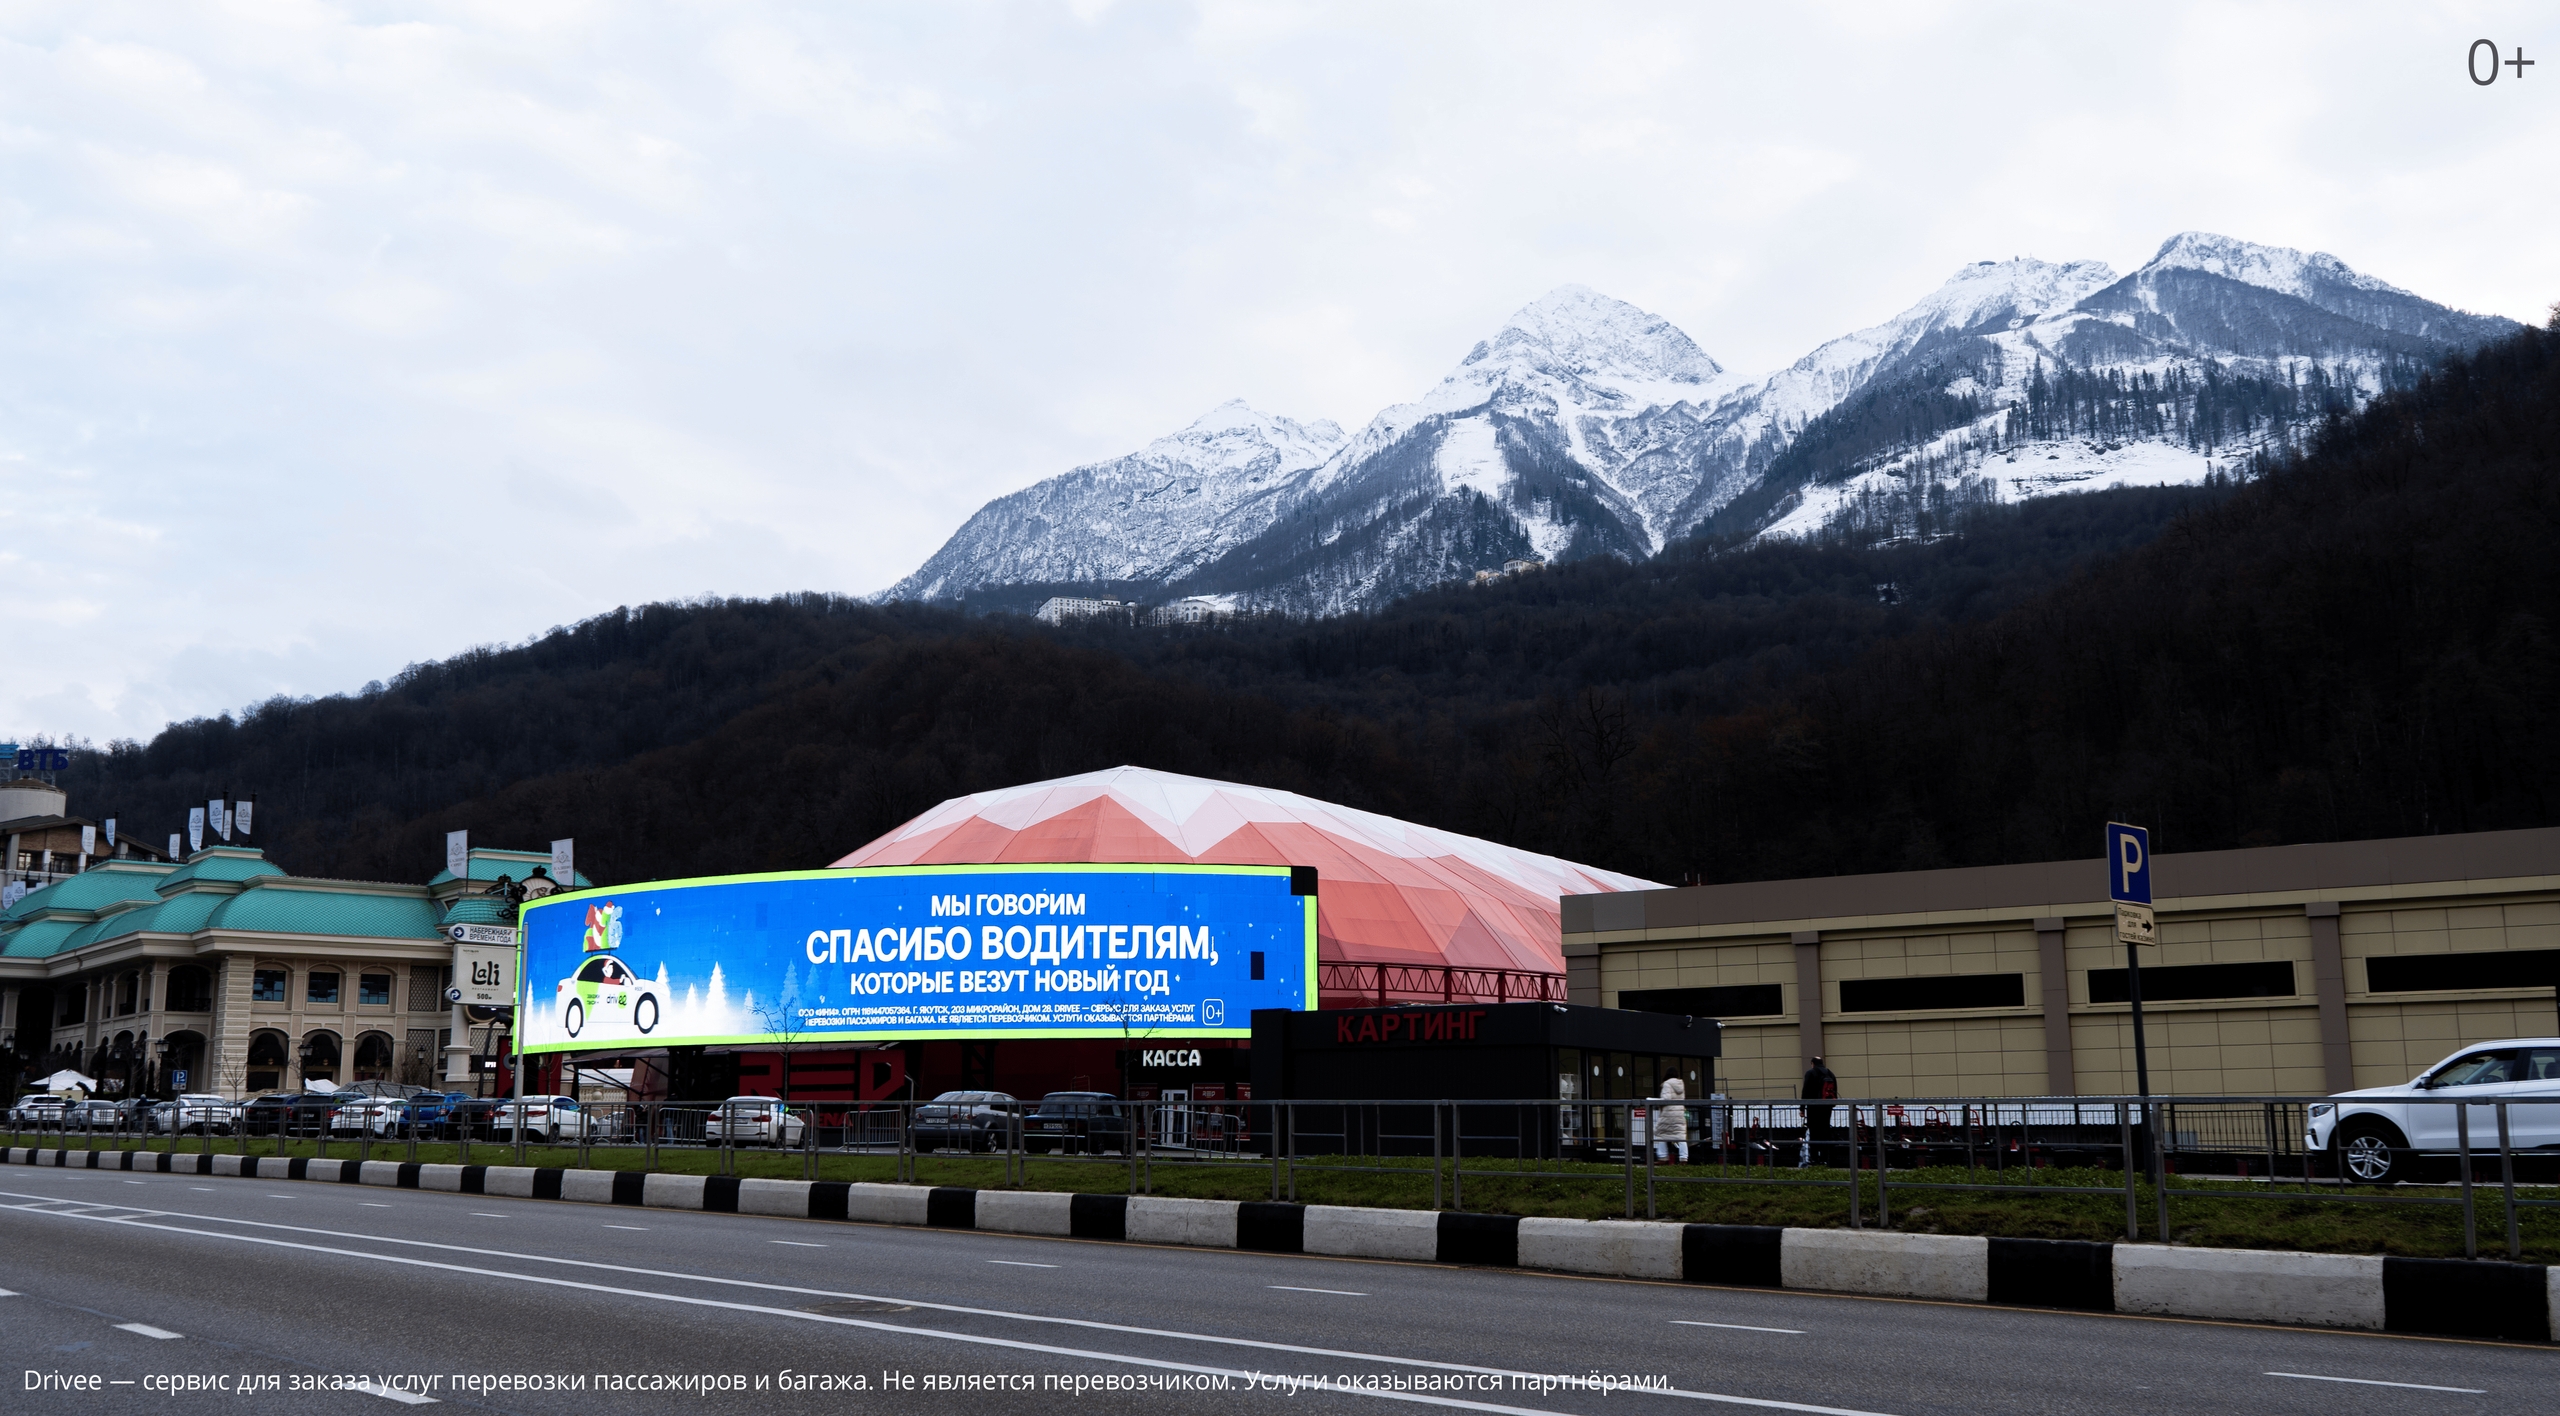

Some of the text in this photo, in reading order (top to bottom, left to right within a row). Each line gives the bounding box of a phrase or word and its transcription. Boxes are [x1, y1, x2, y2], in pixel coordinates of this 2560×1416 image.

[17, 748, 70, 771] ВТБ
[2119, 832, 2143, 894] P
[931, 893, 1086, 917] МЫ ГОВОРИМ
[469, 927, 508, 936] НАБЕРЕЖНАЯ
[469, 933, 512, 943] ВРЕМЕНА ГОДА
[806, 925, 1220, 967] СПАСИБО ВОДИТЕЛЯМ,
[850, 964, 1170, 996] КОТОРЫЕ ВЕЗУТ НОВЫЙ ГОД
[805, 1017, 846, 1027] ПЕРЕВОЗКИ
[846, 1015, 897, 1026] ПАССАЖИРОВ
[897, 1015, 904, 1024] И
[904, 1015, 937, 1024] БАГАЖА.
[938, 1015, 948, 1024] НЕ
[949, 1014, 988, 1024] ЯВЛЯЕТСЯ
[988, 1013, 1052, 1023] ПЕРЕВОЗЧИКОМ.
[1052, 1013, 1083, 1023] УСЛУГИ
[1143, 1013, 1196, 1023] ПАРТНЁРАМИ.
[842, 1007, 861, 1016] ОГРН
[919, 1005, 950, 1015] ЯКУТСК,
[951, 1005, 965, 1014] 203
[966, 1003, 1021, 1014] МИКРОРАЙОН,
[1022, 1004, 1041, 1014] ДОМ
[1054, 1004, 1081, 1013] DRIVEE
[1090, 1004, 1121, 1013] СЕРВИС
[1122, 1004, 1140, 1014] ДЛЯ
[1140, 1004, 1171, 1013] ЗАКАЗА
[1171, 1004, 1196, 1014] УСЛУГ
[1205, 1004, 1223, 1020] 0+
[1337, 1011, 1487, 1043] КАРТИНГ
[1142, 1049, 1202, 1067] КАССА
[738, 1049, 906, 1116] RED
